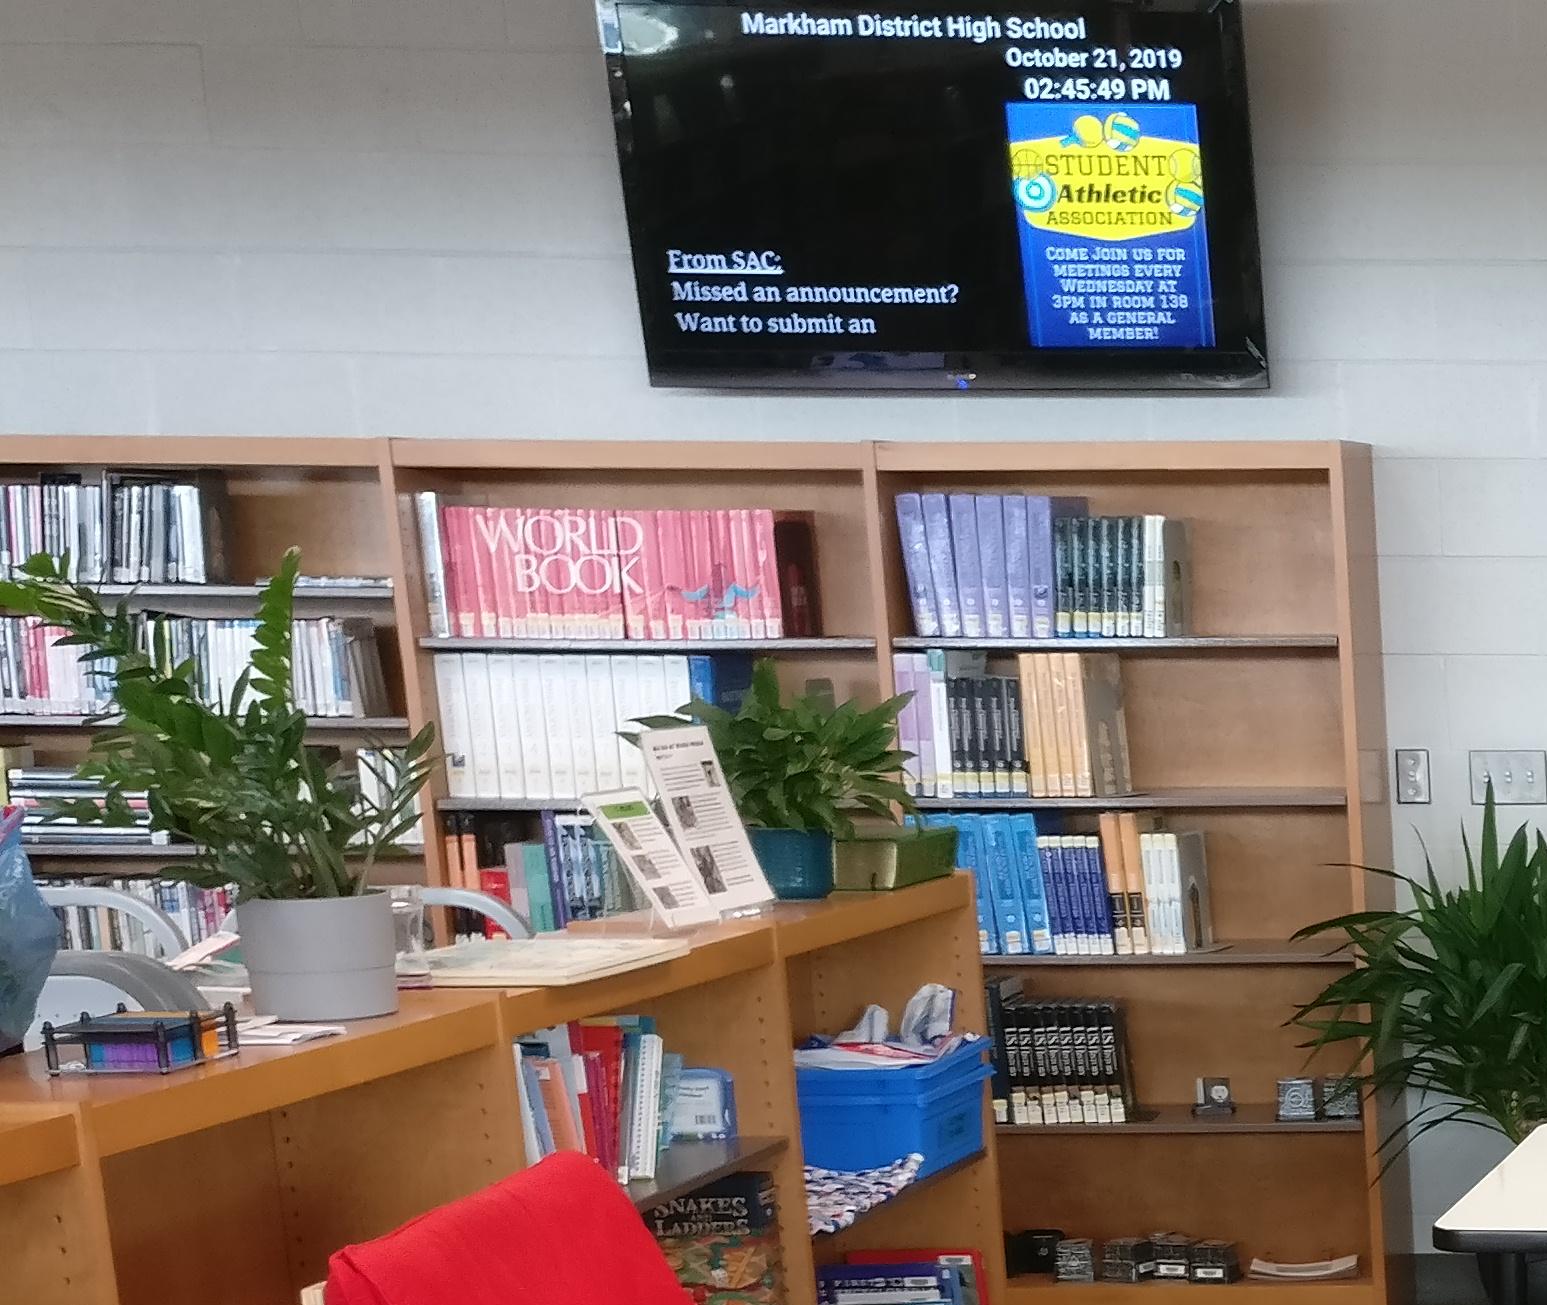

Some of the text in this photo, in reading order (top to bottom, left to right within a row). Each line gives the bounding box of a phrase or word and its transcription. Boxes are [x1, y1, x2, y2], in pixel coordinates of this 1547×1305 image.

[740, 12, 1086, 44] Markham District High School
[1005, 47, 1182, 71] October 21, 2019
[1024, 77, 1170, 100] 02:45:49 PM
[1045, 155, 1167, 177] STUDENT
[1057, 184, 1162, 204] Athletic
[1047, 211, 1173, 226] ASSOCIATION
[667, 249, 784, 274] From SAC:
[1046, 247, 1186, 261] COME JOIN US FOR
[1053, 265, 1182, 278] MEETINGS EVERY
[671, 281, 959, 303] Missed an announcement?
[1061, 280, 1177, 294] WEDNESDAY AT
[1051, 295, 1189, 309] 3PM IN ROOM 138
[675, 313, 877, 333] Want to submit an
[1069, 312, 1176, 325] AS A GENERAL
[1088, 327, 1160, 340] MEMBER!
[476, 515, 645, 555] WORLD
[516, 554, 644, 595] BOOK
[654, 1197, 749, 1218] SNAKES
[655, 1218, 751, 1237] LADDERS
